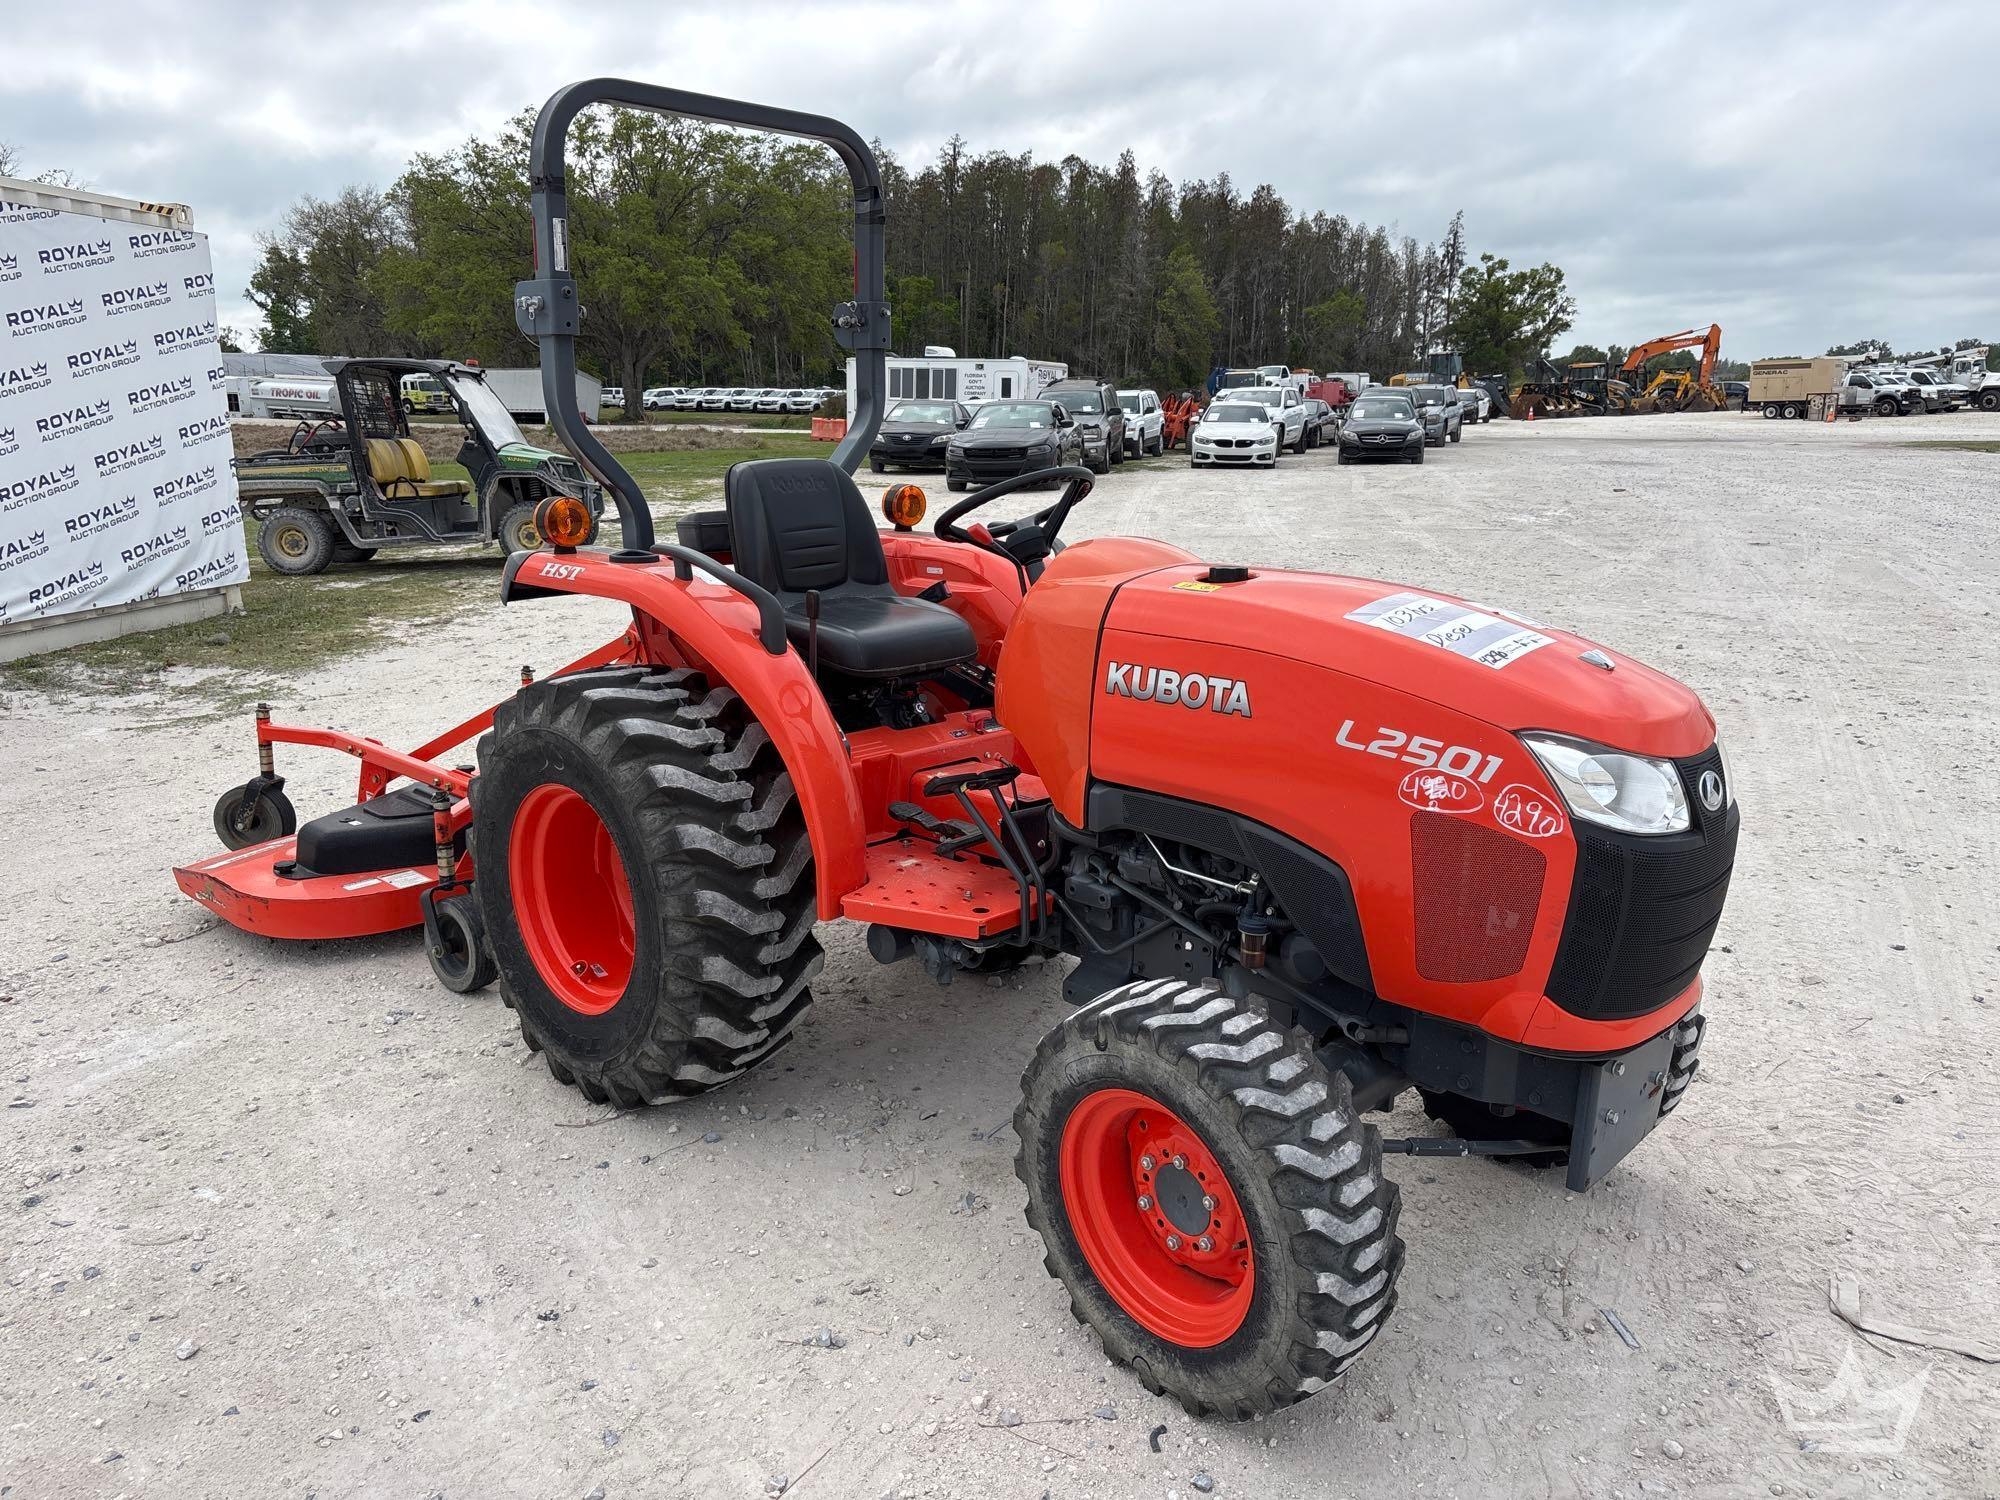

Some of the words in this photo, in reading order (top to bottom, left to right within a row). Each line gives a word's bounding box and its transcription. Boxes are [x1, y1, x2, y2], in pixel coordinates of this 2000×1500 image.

[0, 213, 25, 224] TION
[26, 210, 60, 221] GROUP
[129, 231, 182, 249] ROYAL
[133, 247, 168, 259] AUCTION
[169, 242, 197, 253] GROUP
[38, 243, 98, 264] ROYAL
[44, 260, 84, 275] AUCTION
[85, 255, 115, 268] GROUP
[0, 271, 22, 282] OUP
[183, 273, 213, 289] ROY
[101, 285, 156, 307] ROYAL
[188, 287, 215, 299] AUCTIO
[6, 303, 70, 327] ROYAL
[106, 302, 143, 317] AUCTION
[144, 296, 172, 309] GROUP
[12, 321, 55, 338] AUCTION
[55, 315, 87, 328] GROUP
[153, 324, 205, 347] ROYAL
[66, 344, 125, 369] ROYAL
[158, 341, 193, 356] AUCTION
[193, 335, 218, 347] GROUP
[72, 362, 111, 379] AUCTION
[112, 354, 141, 368] GROUP
[17, 378, 52, 394] GROUP
[127, 381, 180, 406] ROYAL
[270, 387, 304, 399] TROPIC
[305, 391, 321, 400] OIL
[132, 399, 168, 415] AUCTION
[168, 390, 196, 404] GROUP
[36, 405, 97, 433] ROYAL
[41, 424, 83, 443] AUCTION
[83, 414, 114, 430] GROUP
[178, 415, 226, 440] ROYAL
[0, 443, 20, 457] OUP
[182, 432, 216, 449] AUCTION
[216, 427, 230, 438] GRO
[94, 441, 150, 469] ROYAL
[99, 459, 137, 479] AUCTION
[137, 449, 167, 465] GROUP
[0, 471, 62, 503] ROYAL
[3, 491, 47, 513] AUCTION
[46, 479, 80, 497] GROUP
[153, 472, 204, 499] ROYAL
[158, 489, 193, 508] AUCTION
[193, 479, 218, 494] GROUP
[64, 503, 123, 533] ROYAL
[70, 521, 109, 543] AUCTION
[110, 509, 140, 527] GROUP
[201, 504, 239, 529] ROYA
[204, 518, 236, 538] AUCTION
[15, 545, 50, 565] GROUP
[121, 533, 174, 563] ROYAL
[127, 551, 161, 573] AUCTION
[161, 539, 191, 557] GROUP
[175, 558, 226, 588] ROYAL
[180, 575, 214, 594] AUCTION
[214, 564, 239, 581] GROUP
[538, 562, 586, 581] HST
[29, 569, 89, 604] ROYAL
[33, 588, 77, 613] AUCTION
[77, 575, 109, 594] GROUP
[1382, 609, 1413, 628] 103
[1425, 624, 1475, 648] Diesel
[1105, 660, 1252, 718] KUBOTA
[1335, 719, 1504, 784] L2501
[1494, 793, 1558, 836] 4290
